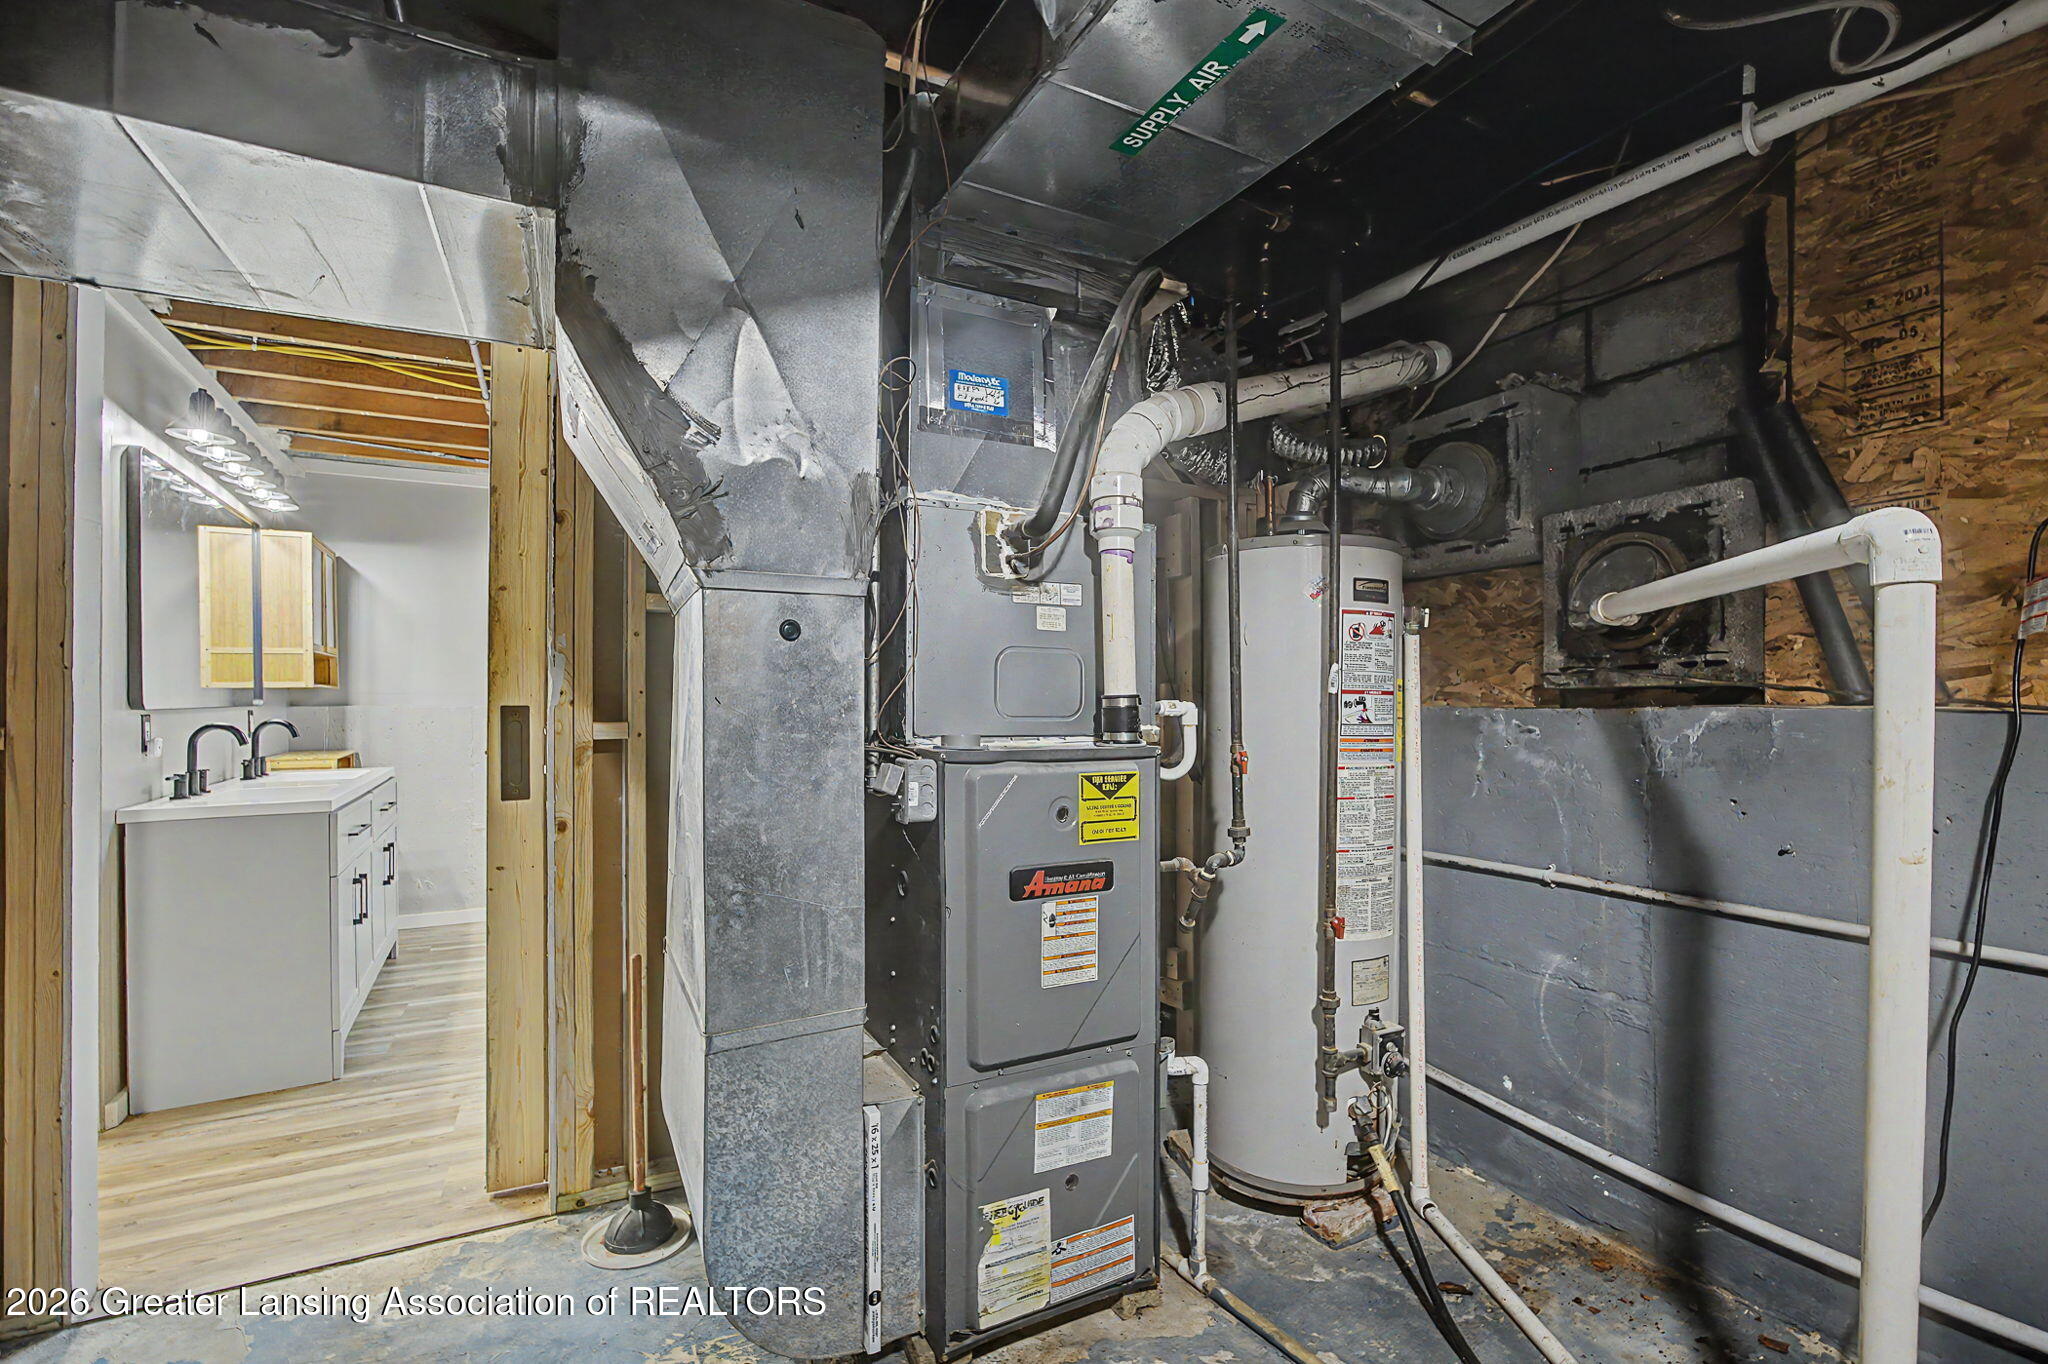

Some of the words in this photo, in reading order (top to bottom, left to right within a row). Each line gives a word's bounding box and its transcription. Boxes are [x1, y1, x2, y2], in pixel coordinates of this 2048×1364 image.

[1123, 92, 1189, 148] SUPPLY
[1188, 60, 1229, 91] AIR
[1022, 870, 1106, 898] Amana
[870, 1122, 879, 1134] 16
[871, 1143, 879, 1155] 25
